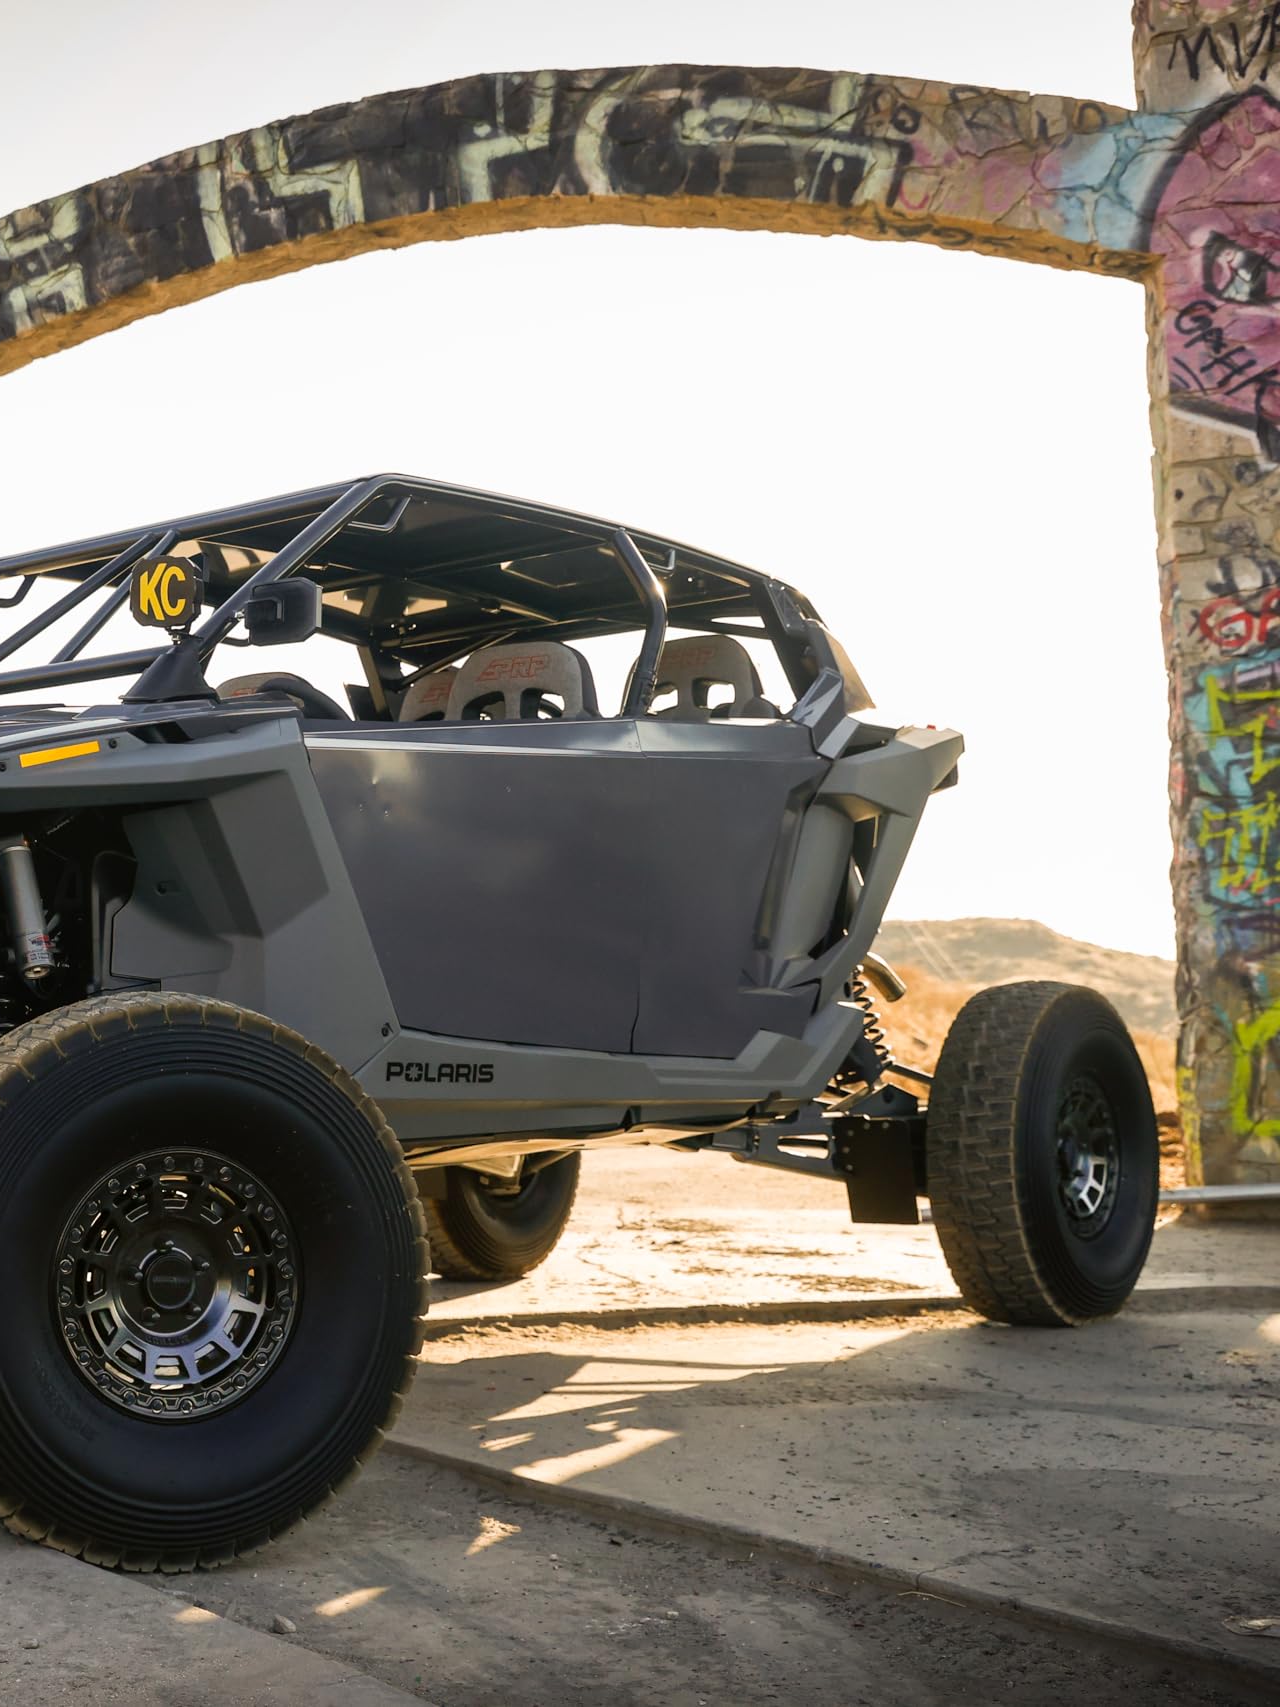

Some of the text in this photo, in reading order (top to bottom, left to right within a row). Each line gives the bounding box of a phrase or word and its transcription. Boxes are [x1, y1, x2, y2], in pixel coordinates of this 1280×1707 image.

[140, 563, 186, 621] KC
[477, 655, 548, 682] PRP
[386, 1062, 494, 1083] POLARIS
